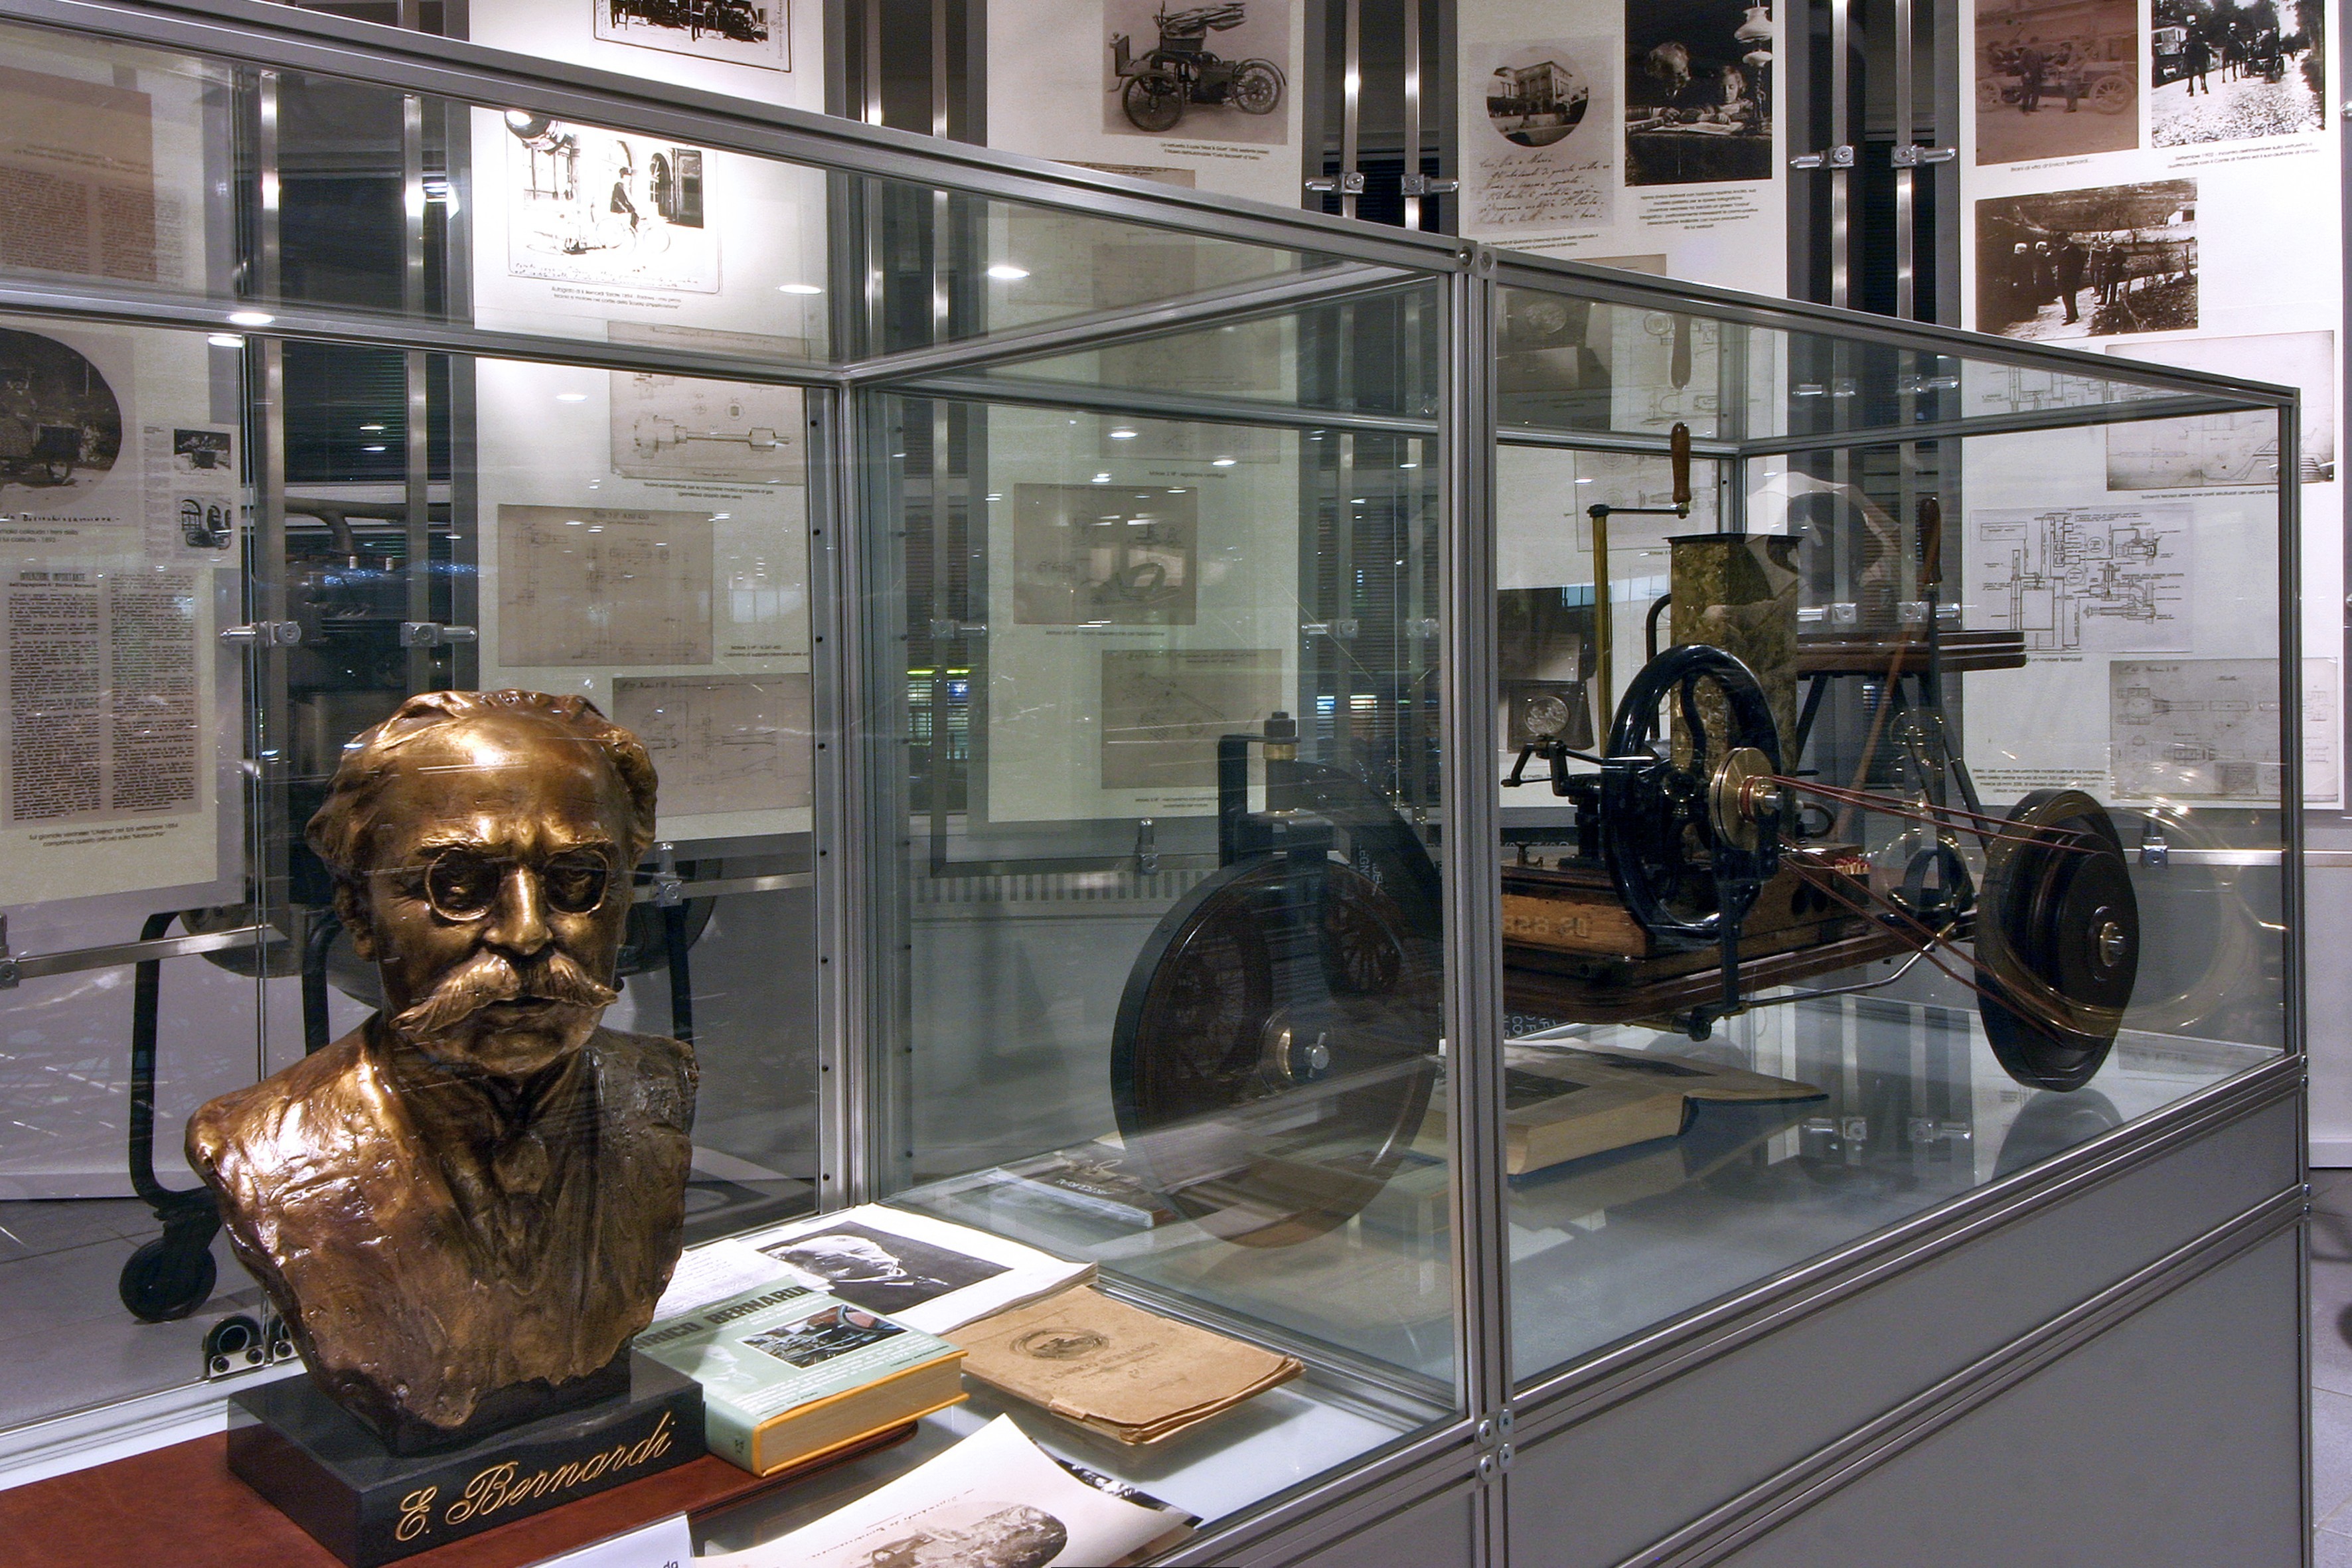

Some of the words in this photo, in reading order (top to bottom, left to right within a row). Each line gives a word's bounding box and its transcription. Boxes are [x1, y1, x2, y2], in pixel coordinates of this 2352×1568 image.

[703, 1285, 815, 1325] BERNARDI
[395, 1485, 438, 1542] E.
[445, 1411, 676, 1526] Bernardi
